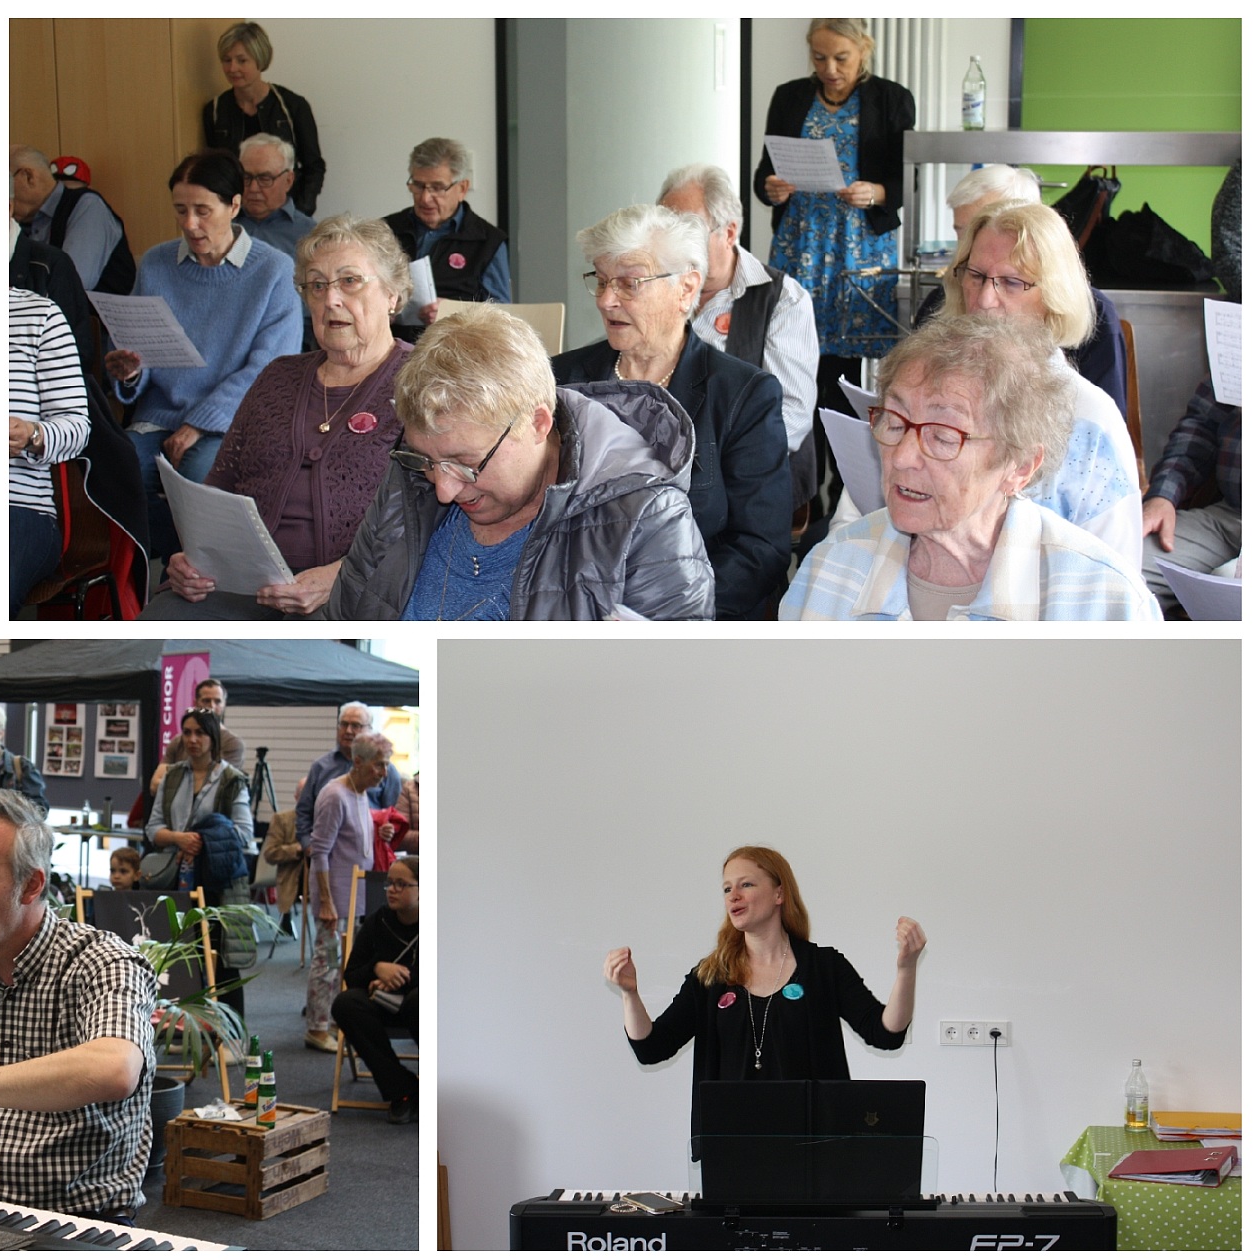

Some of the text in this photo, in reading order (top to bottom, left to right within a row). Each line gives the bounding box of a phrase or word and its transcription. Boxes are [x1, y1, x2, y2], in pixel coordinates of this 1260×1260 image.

[163, 666, 174, 725] CHOR
[567, 1231, 667, 1251] Roland
[970, 1234, 1061, 1251] FP-7
